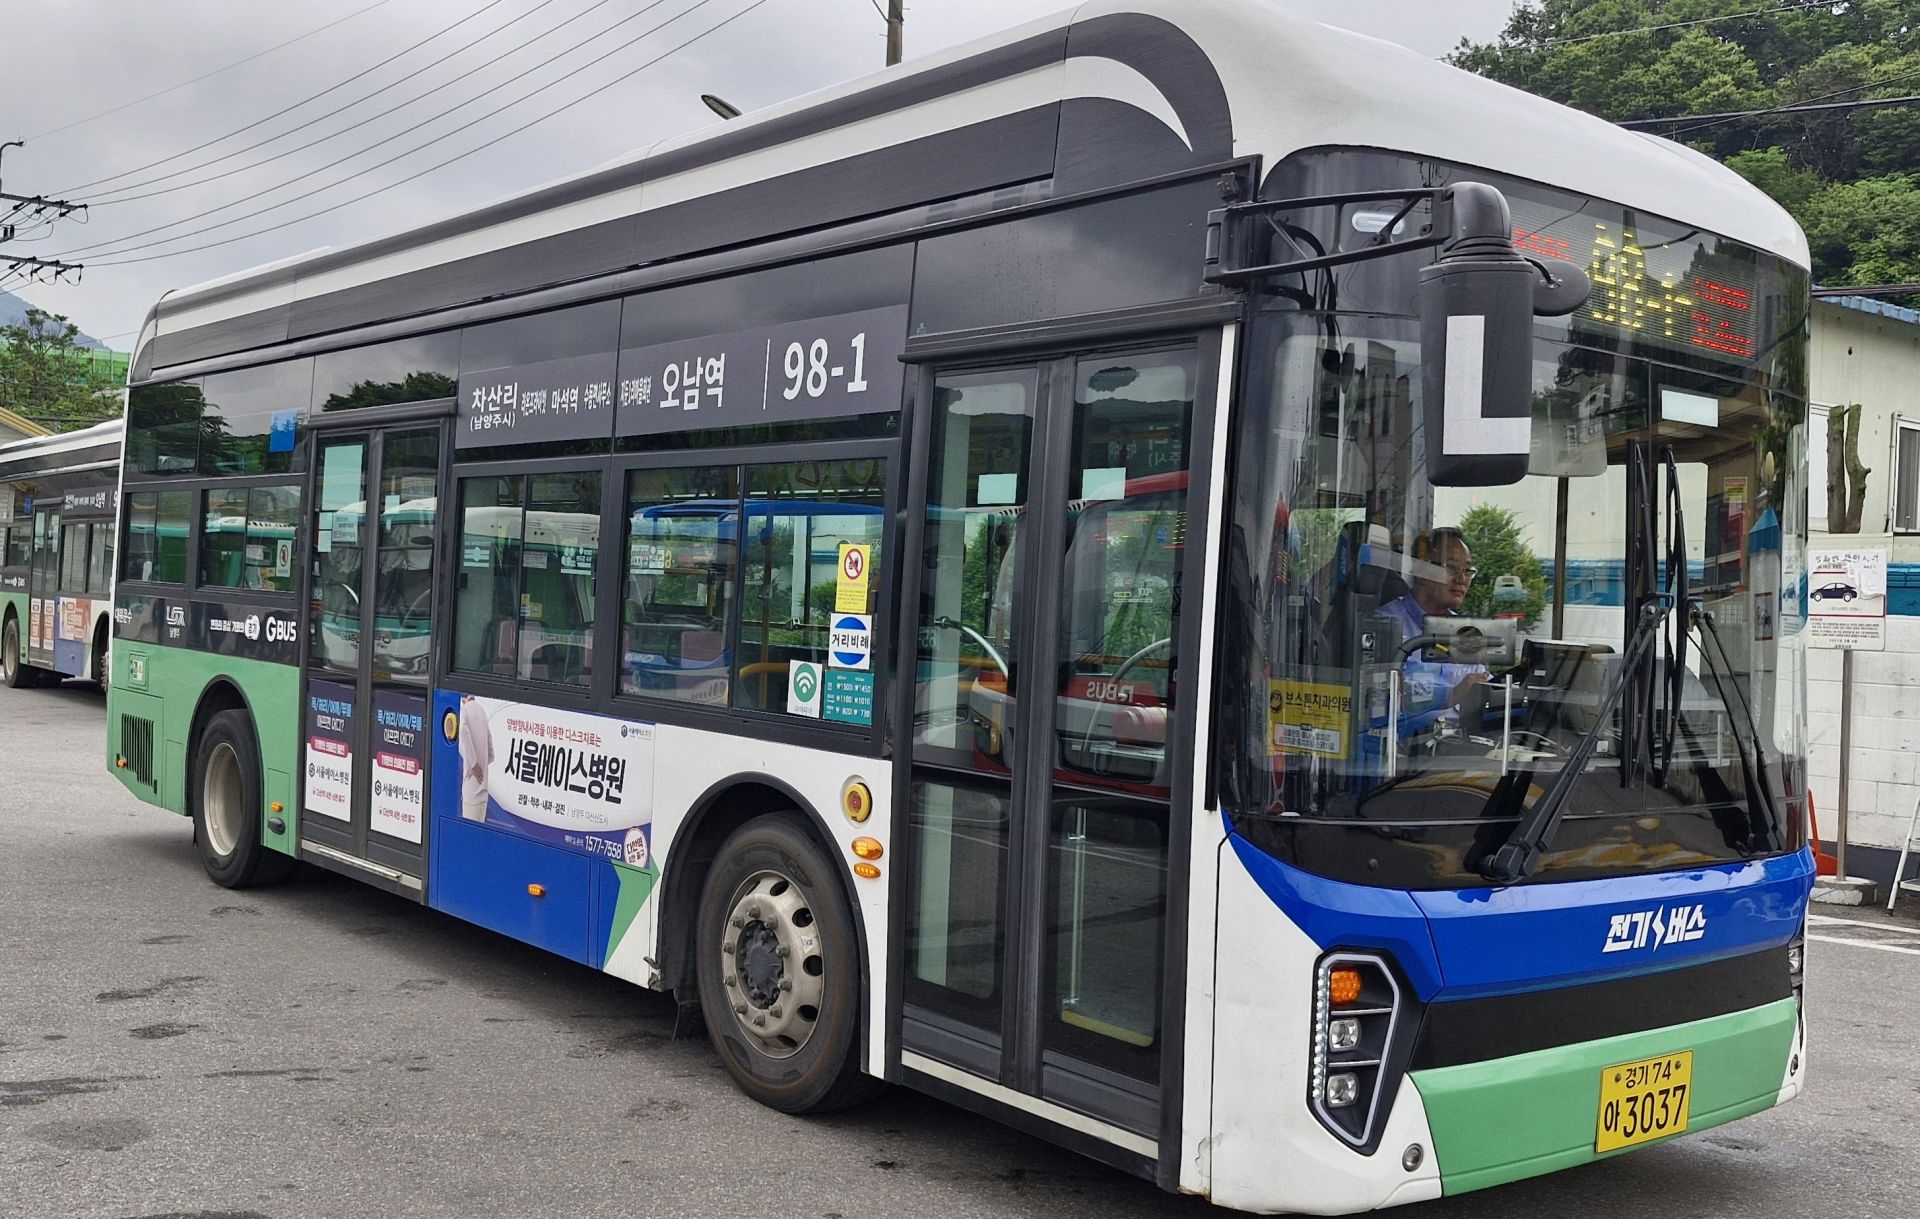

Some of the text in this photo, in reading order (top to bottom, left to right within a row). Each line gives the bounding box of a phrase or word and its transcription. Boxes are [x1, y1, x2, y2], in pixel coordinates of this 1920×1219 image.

[783, 333, 868, 400] 98-1
[472, 382, 518, 412] 차산리
[552, 386, 578, 414] 마석역
[660, 353, 726, 410] 오남역
[470, 412, 516, 432] (남양주시)
[266, 616, 297, 642] GBUS
[832, 634, 869, 649] 거리비례
[546, 725, 564, 741] 이용한
[566, 729, 602, 748] 디스크치료는
[316, 766, 350, 786] 서울에이스병원
[504, 738, 626, 804] 서울에이스병원
[382, 784, 420, 804] 서울에이스병원
[586, 835, 622, 859] 1577-7558
